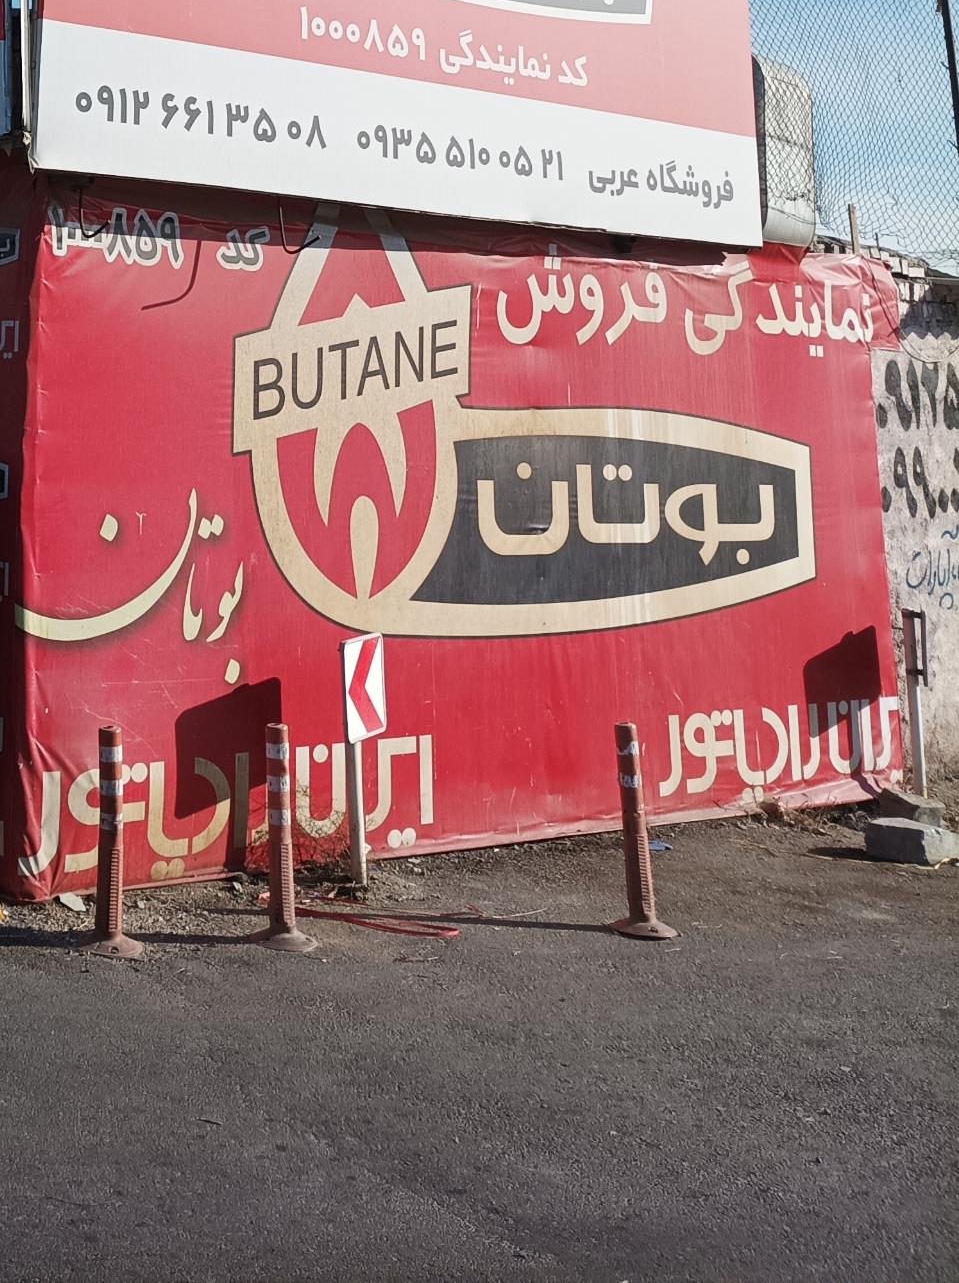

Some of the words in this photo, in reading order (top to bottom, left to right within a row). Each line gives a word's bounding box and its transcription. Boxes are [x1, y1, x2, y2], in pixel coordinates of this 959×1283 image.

[300, 5, 427, 63] ۱۰۰۰۸۵۹
[438, 30, 552, 88] نمایندگی
[558, 55, 589, 88] کد
[74, 84, 151, 125] ۰۹۱۲
[159, 93, 215, 131] ۶۶۱
[226, 102, 278, 144] ۳۵
[286, 115, 328, 150] ۰۸
[356, 126, 437, 166] ۰۹۳۵
[444, 139, 491, 169] ۵۱۰
[498, 147, 535, 179] ۰۵
[540, 149, 565, 183] ۲۱
[587, 166, 640, 196] عربی
[646, 163, 735, 210] فروشگاه
[218, 227, 268, 269] کد
[496, 243, 668, 345] فروش
[683, 261, 876, 358] نمایندگی
[251, 321, 460, 422] BUTANE
[476, 462, 776, 567] بوتان
[658, 704, 821, 804] رادیاتور
[827, 695, 902, 784] یران
